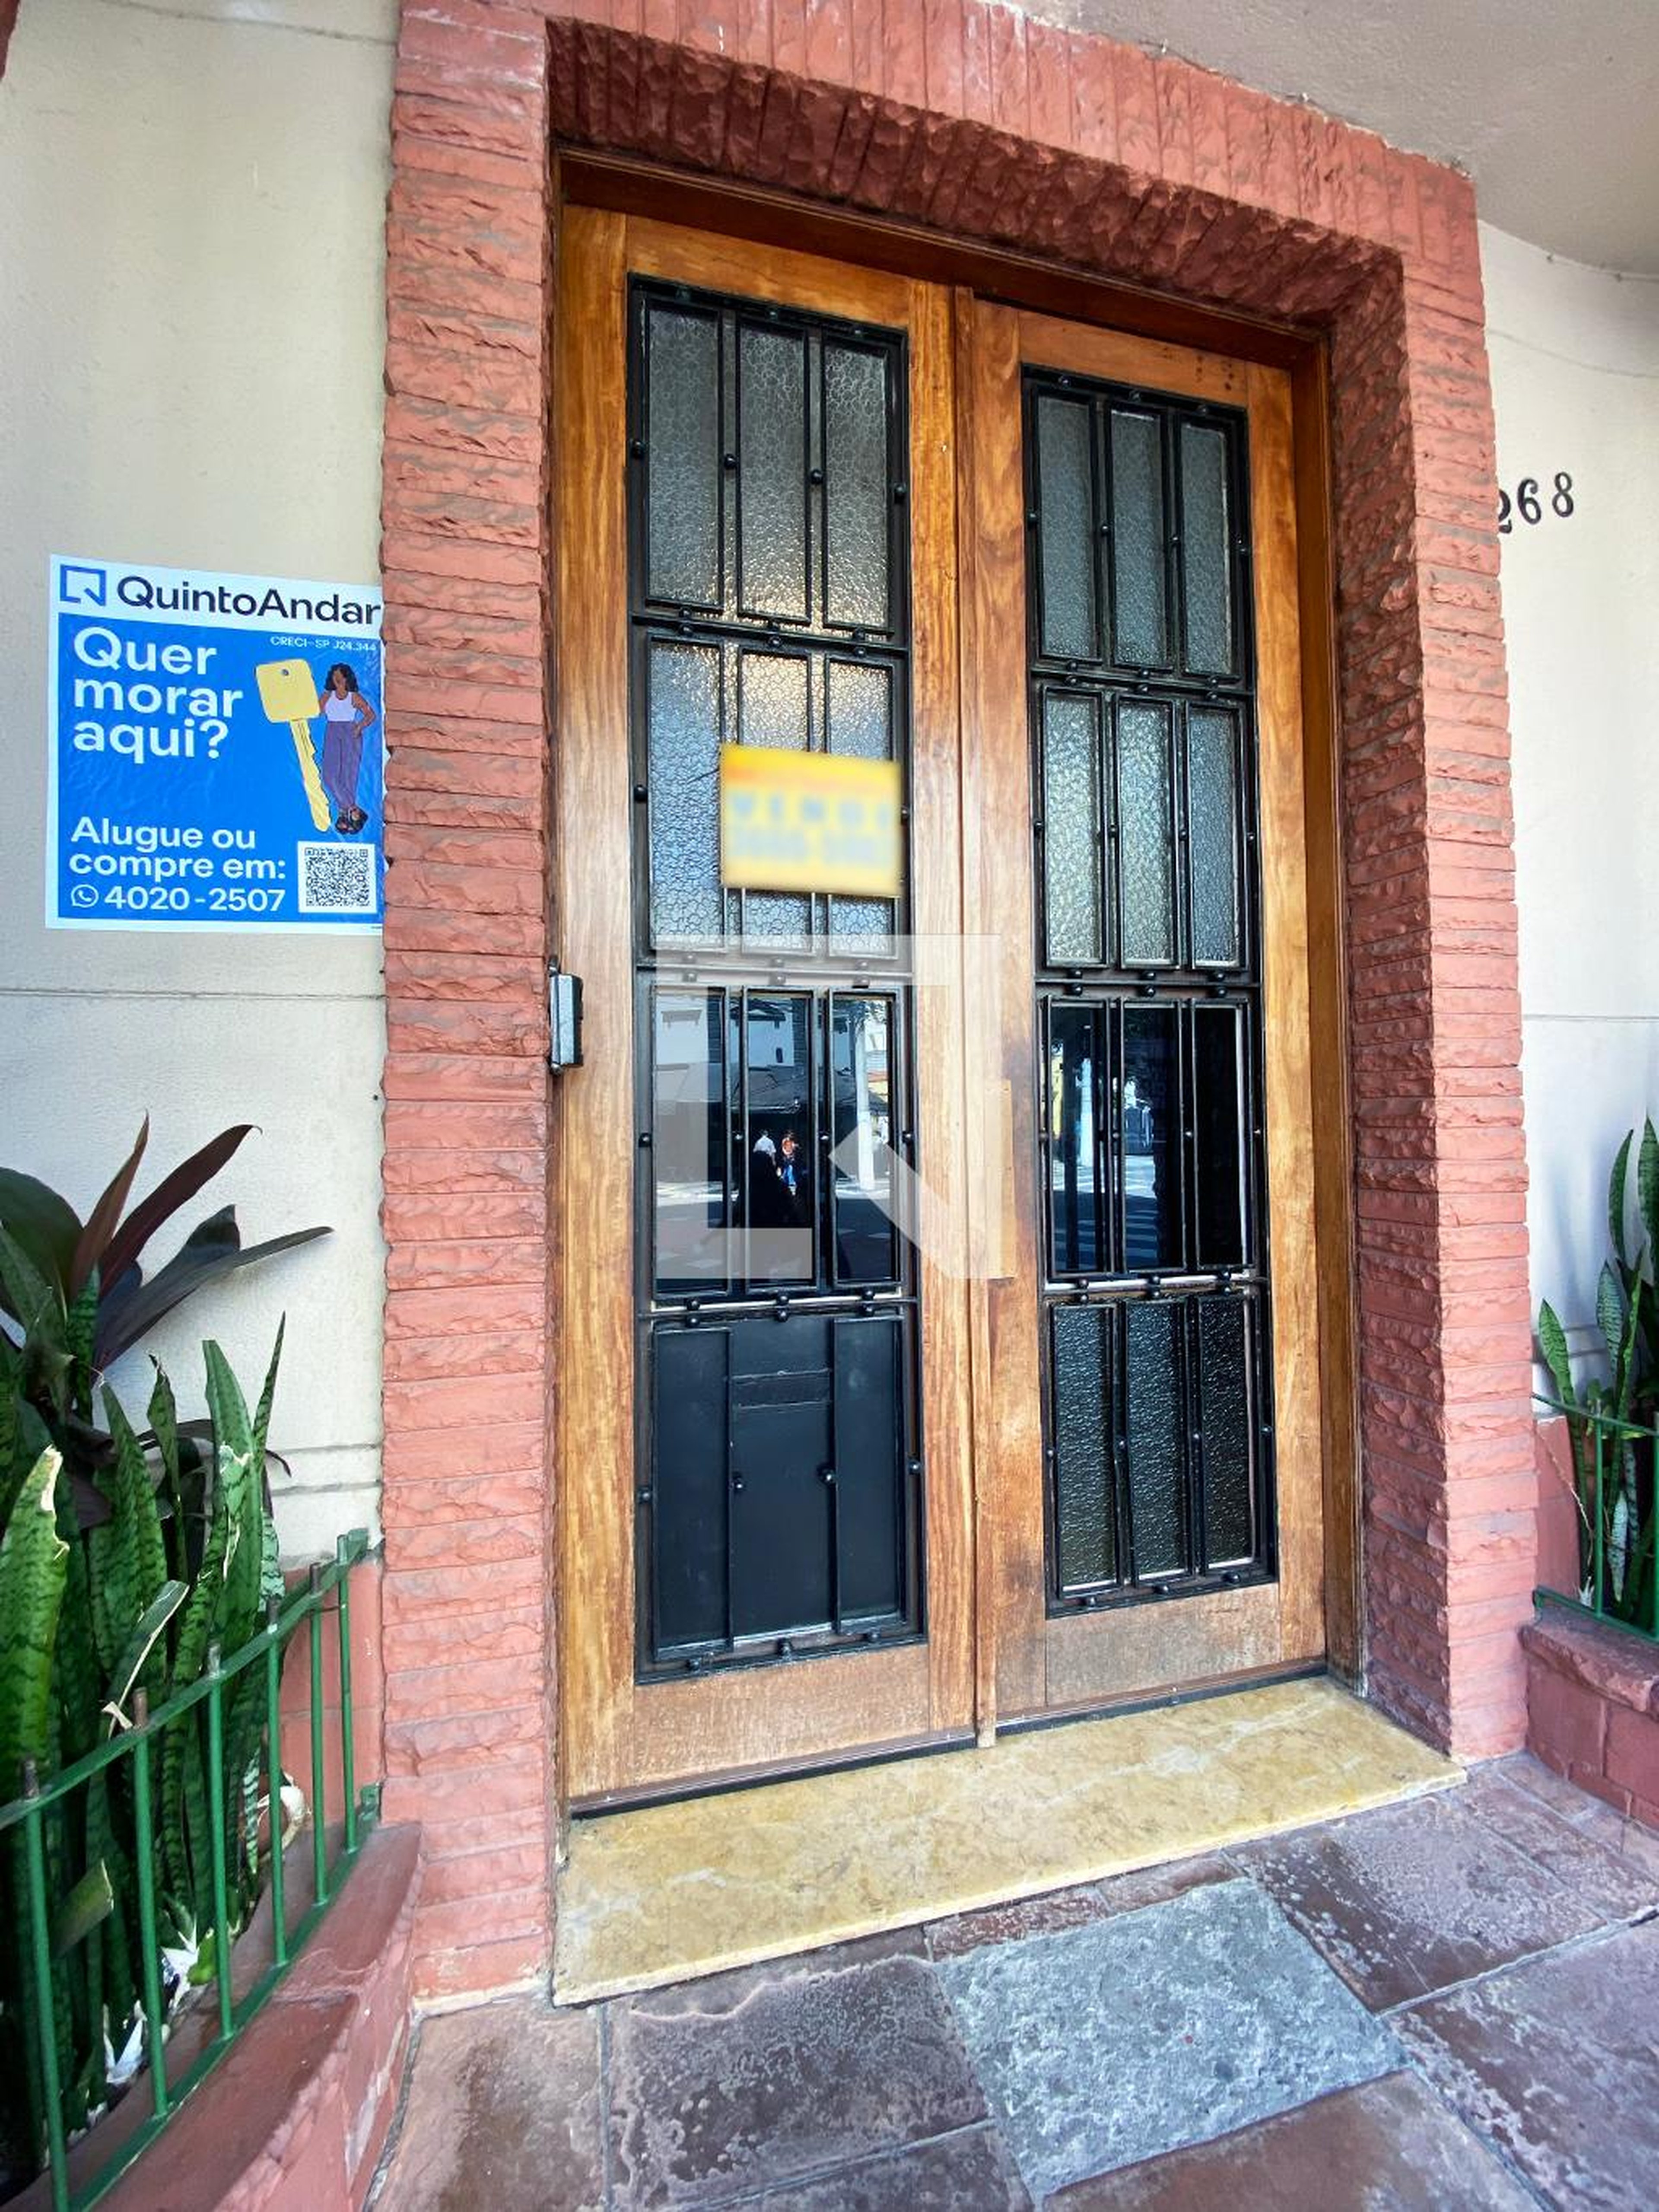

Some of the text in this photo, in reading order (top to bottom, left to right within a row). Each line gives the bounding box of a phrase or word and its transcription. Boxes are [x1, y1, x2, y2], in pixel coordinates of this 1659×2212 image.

[117, 575, 381, 624] QuintoAndar
[73, 627, 217, 675] Quer
[74, 677, 243, 717] morar
[73, 719, 229, 764] aqui?
[71, 816, 255, 852] Alugue ou
[69, 853, 286, 882] compre em:
